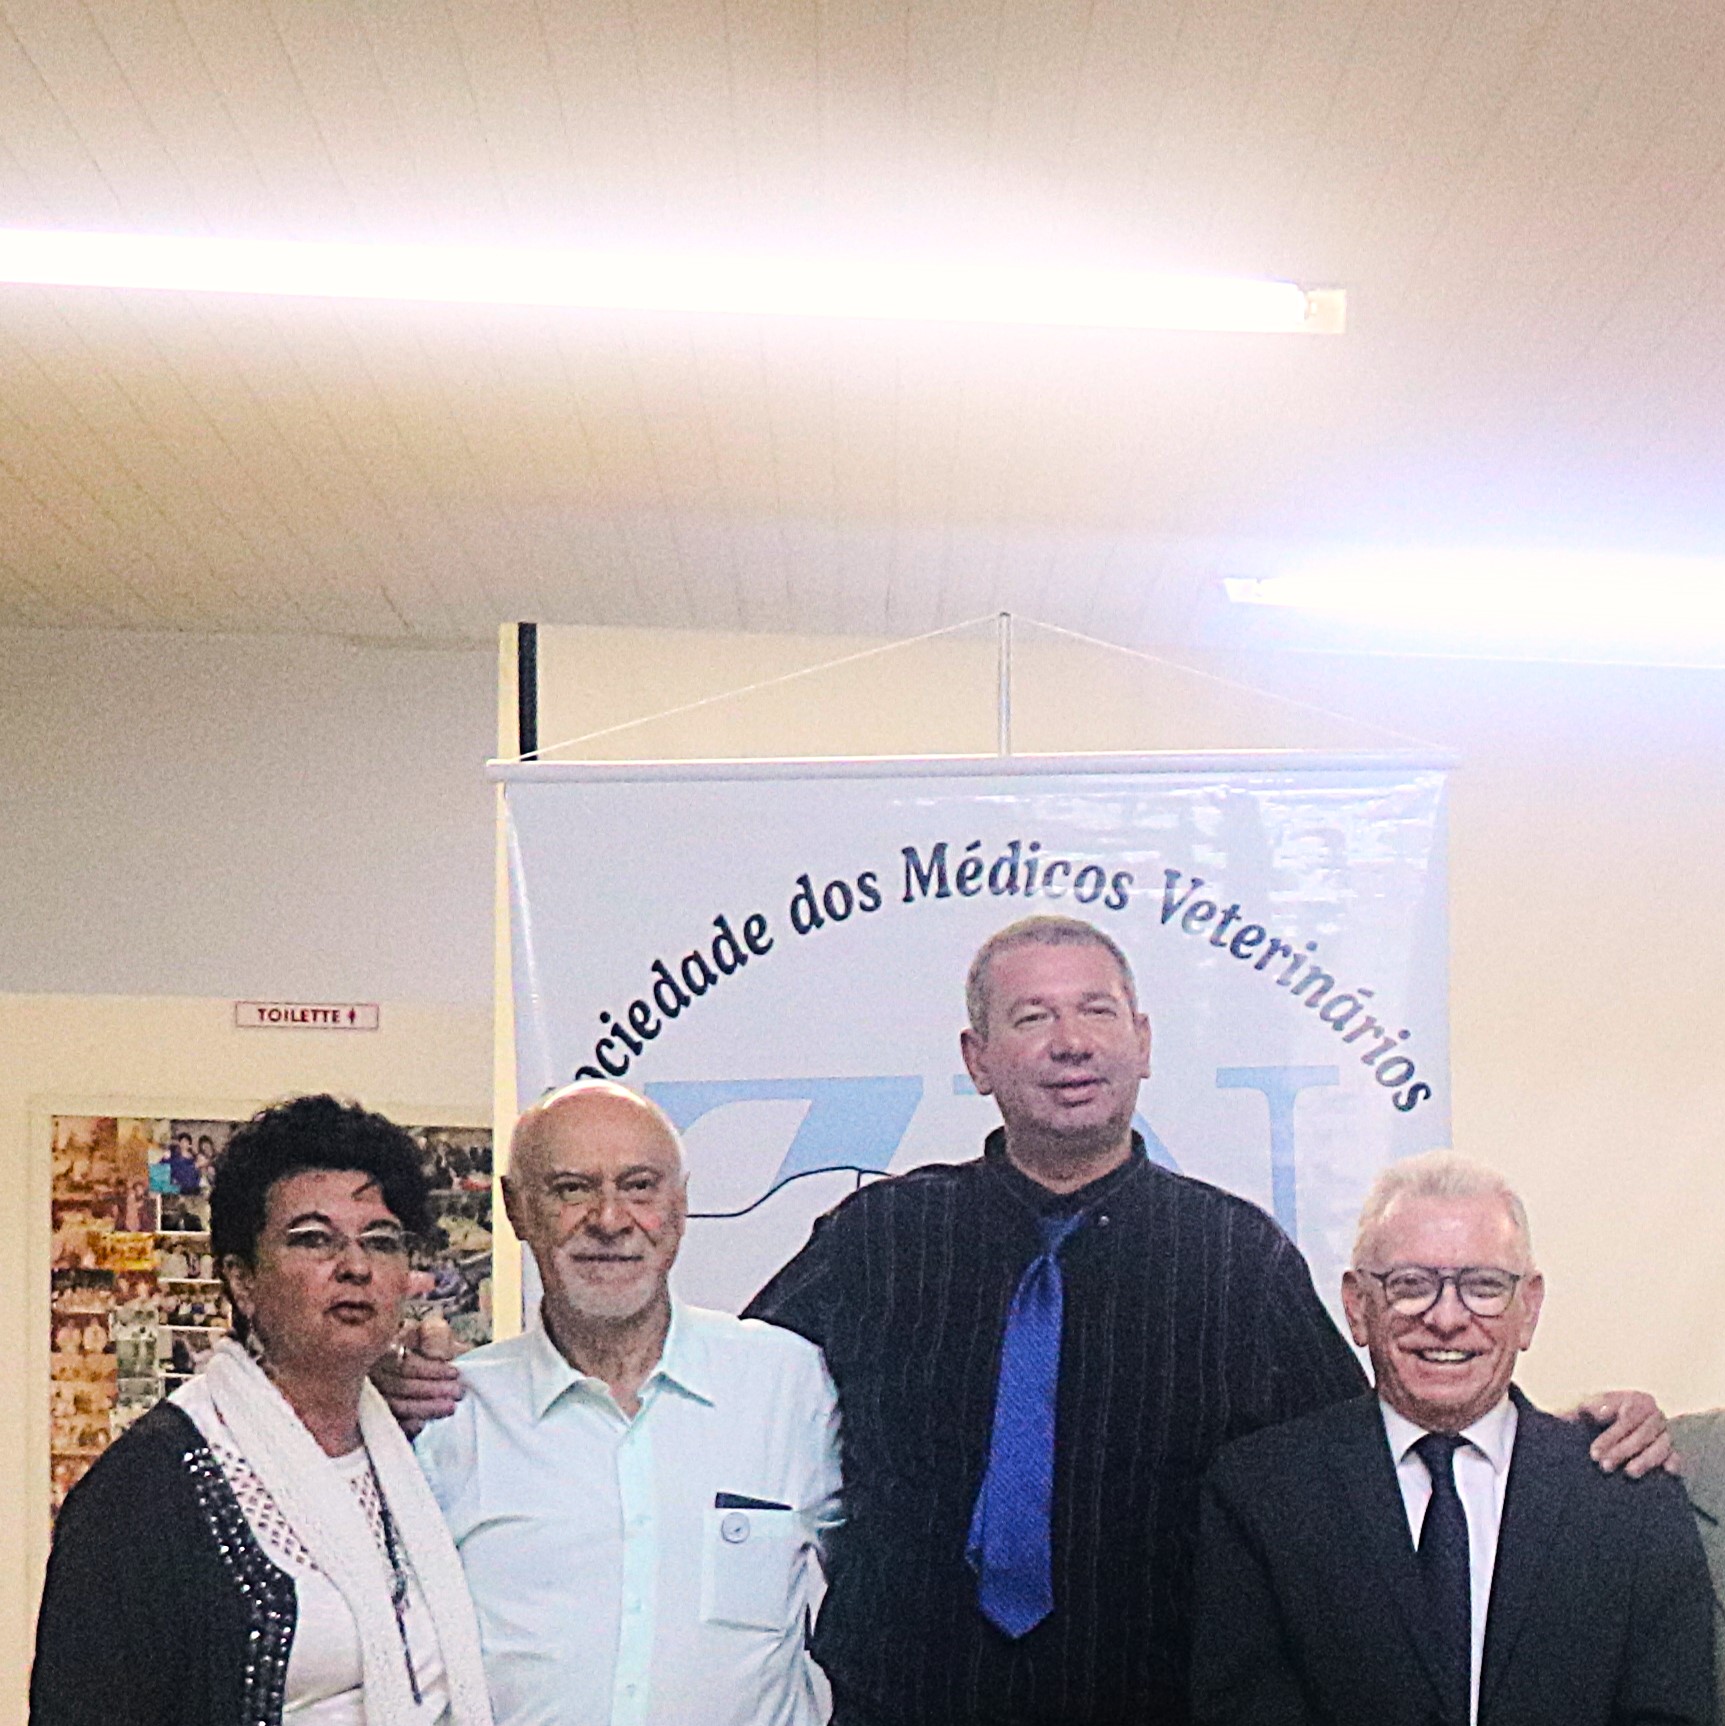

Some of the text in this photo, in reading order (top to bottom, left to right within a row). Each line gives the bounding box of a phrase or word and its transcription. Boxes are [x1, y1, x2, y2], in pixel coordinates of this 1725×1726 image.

[257, 1007, 340, 1023] TOILETTE
[574, 839, 1431, 1114] ciedade dos Médicos Veterinários
